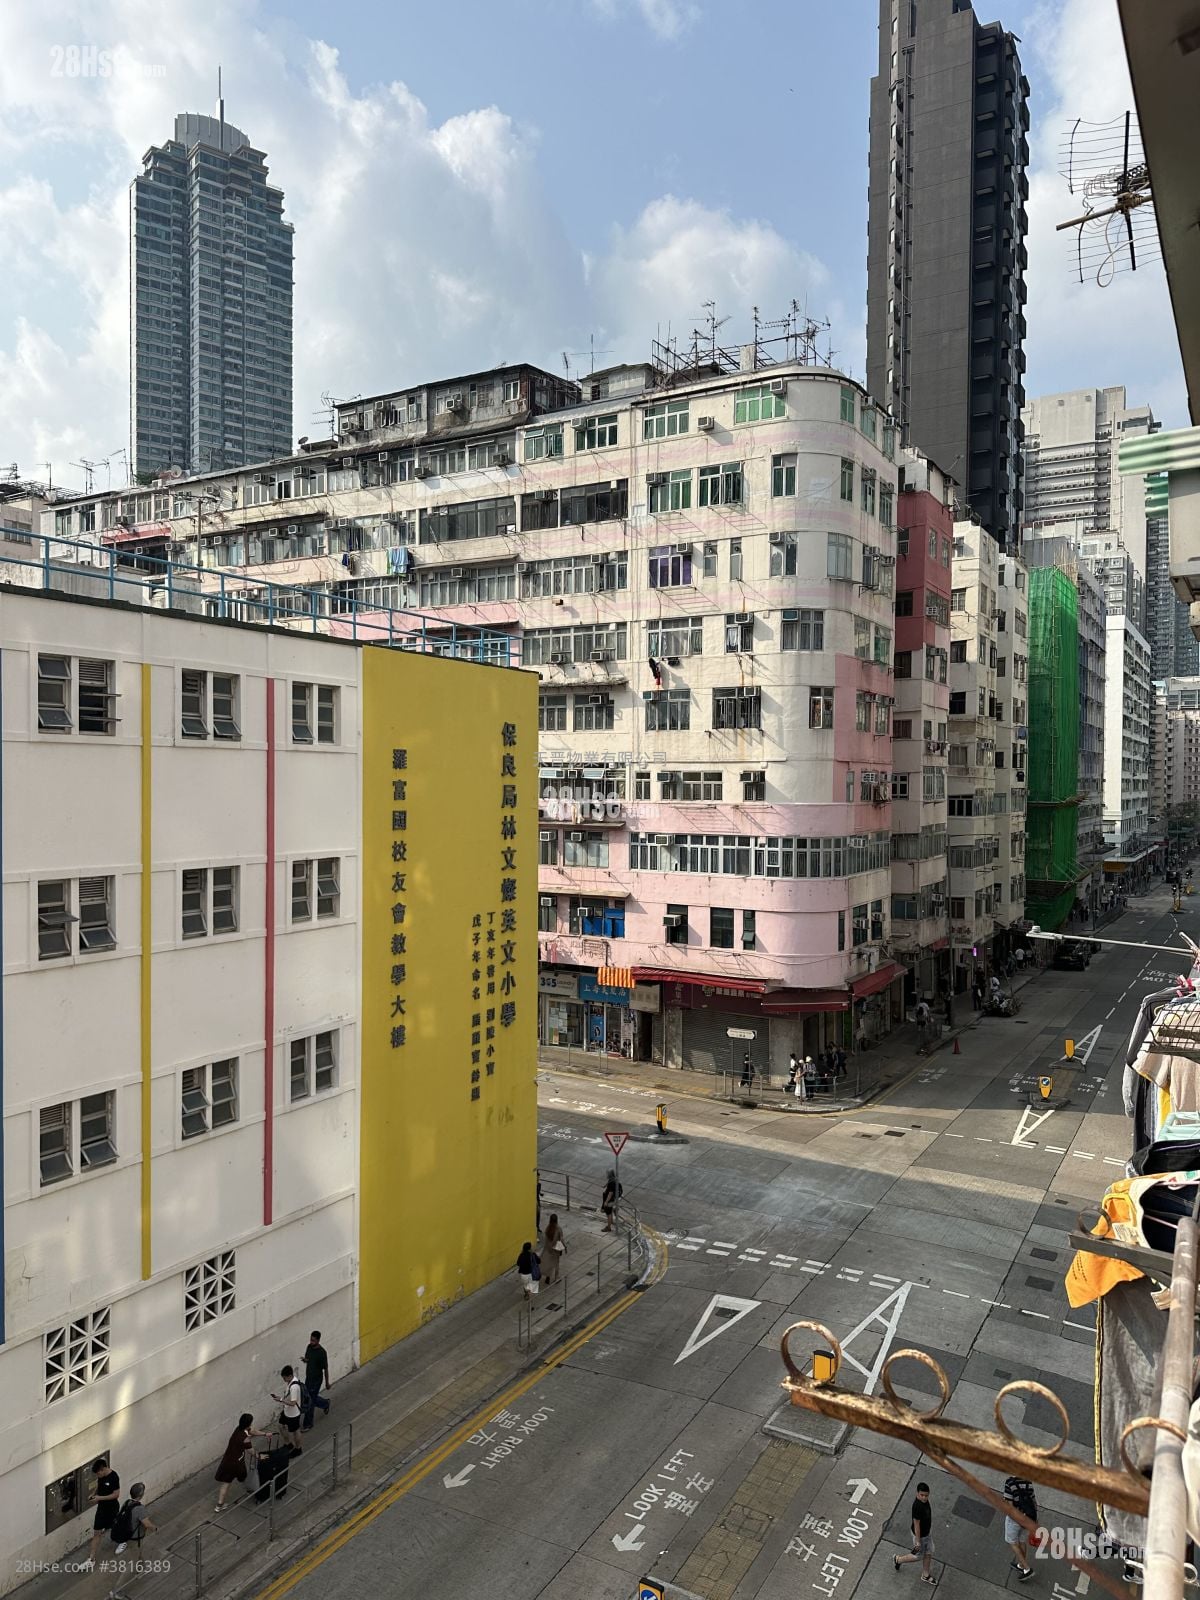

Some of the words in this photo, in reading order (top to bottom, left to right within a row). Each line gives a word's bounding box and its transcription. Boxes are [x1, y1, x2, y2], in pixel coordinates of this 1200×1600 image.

[501, 721, 517, 1028] 保良局林文燦英文小學
[391, 749, 408, 1049] 羅富國校友會教學大樓
[516, 1406, 555, 1435] LOOK
[480, 1436, 524, 1469] RIGHT
[624, 1483, 666, 1521] LOOK
[657, 1448, 695, 1481] LEFT
[837, 1507, 874, 1548] LOOK
[812, 1552, 850, 1598] LEFT
